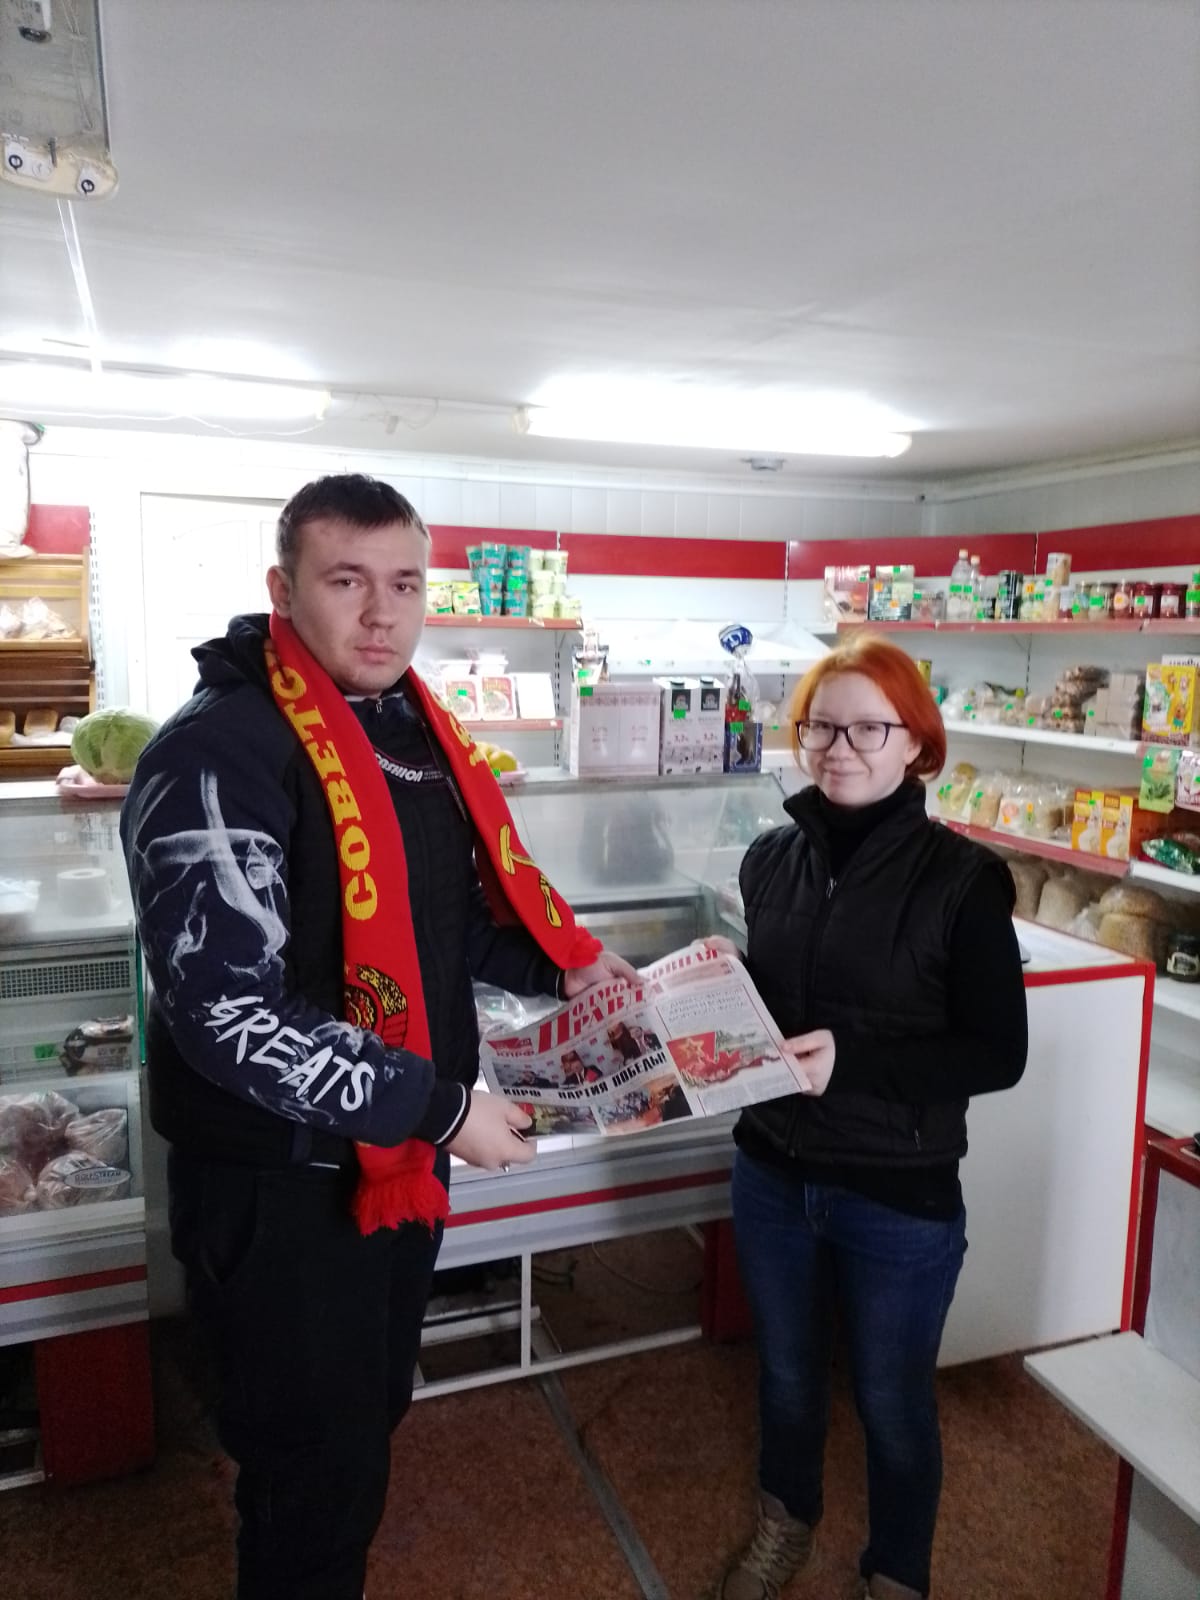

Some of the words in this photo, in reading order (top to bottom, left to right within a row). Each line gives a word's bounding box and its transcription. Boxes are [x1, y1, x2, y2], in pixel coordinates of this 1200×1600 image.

[204, 995, 375, 1111] GREATS
[503, 1087, 542, 1098] КПРФ
[558, 1081, 609, 1099] ПАРТИЯ
